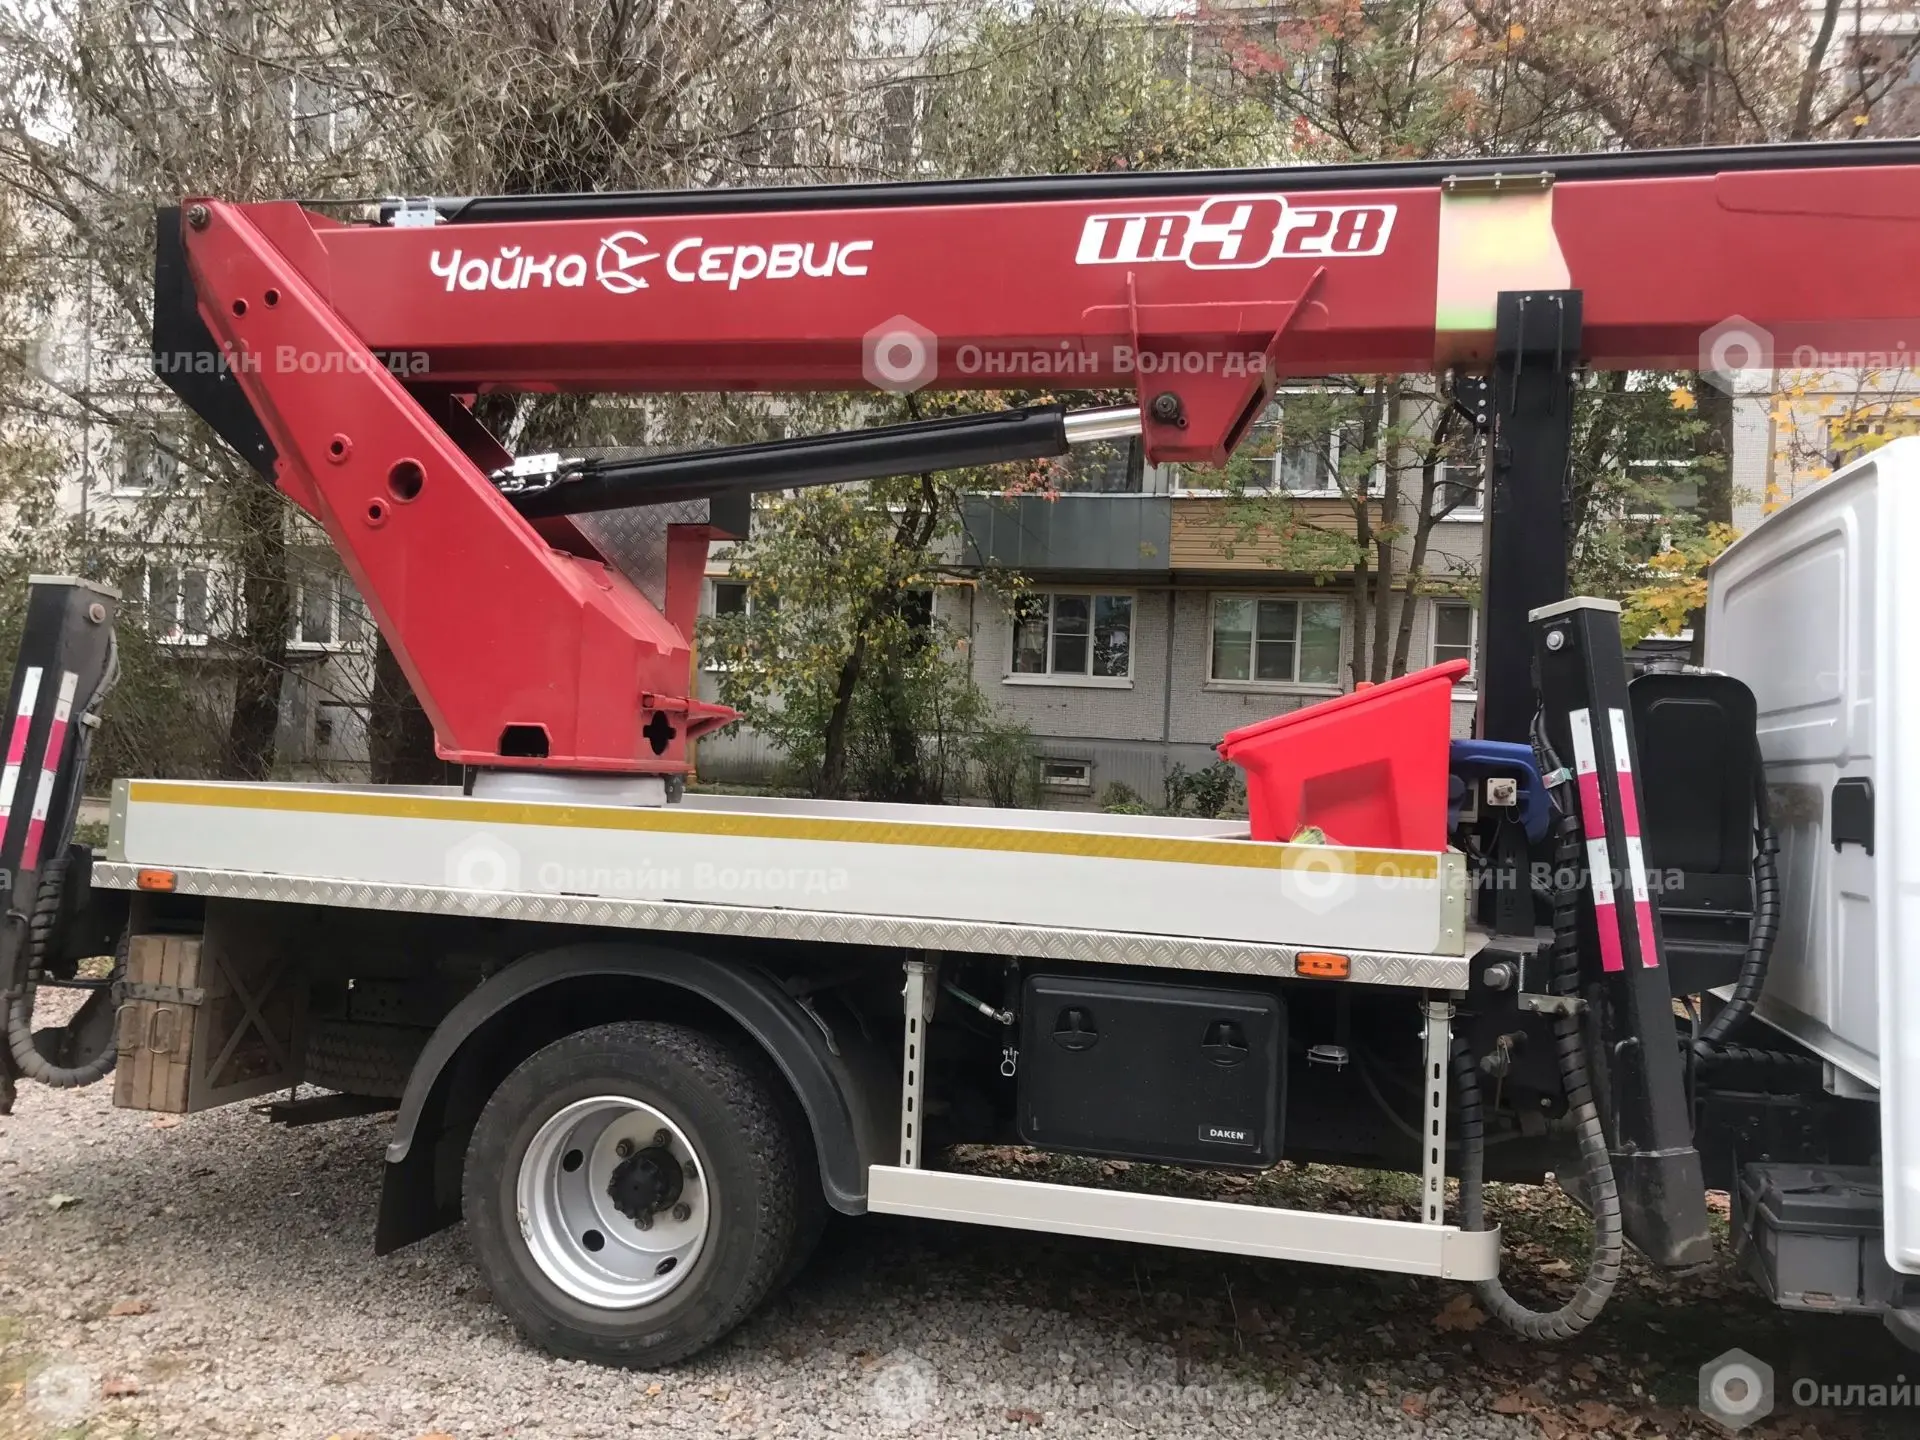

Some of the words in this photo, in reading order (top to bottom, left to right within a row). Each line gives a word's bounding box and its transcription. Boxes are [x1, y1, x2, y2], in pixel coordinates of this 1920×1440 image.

[429, 245, 587, 292] Чайка
[665, 237, 875, 291] Сервис
[1209, 1128, 1245, 1140] DAKEN
